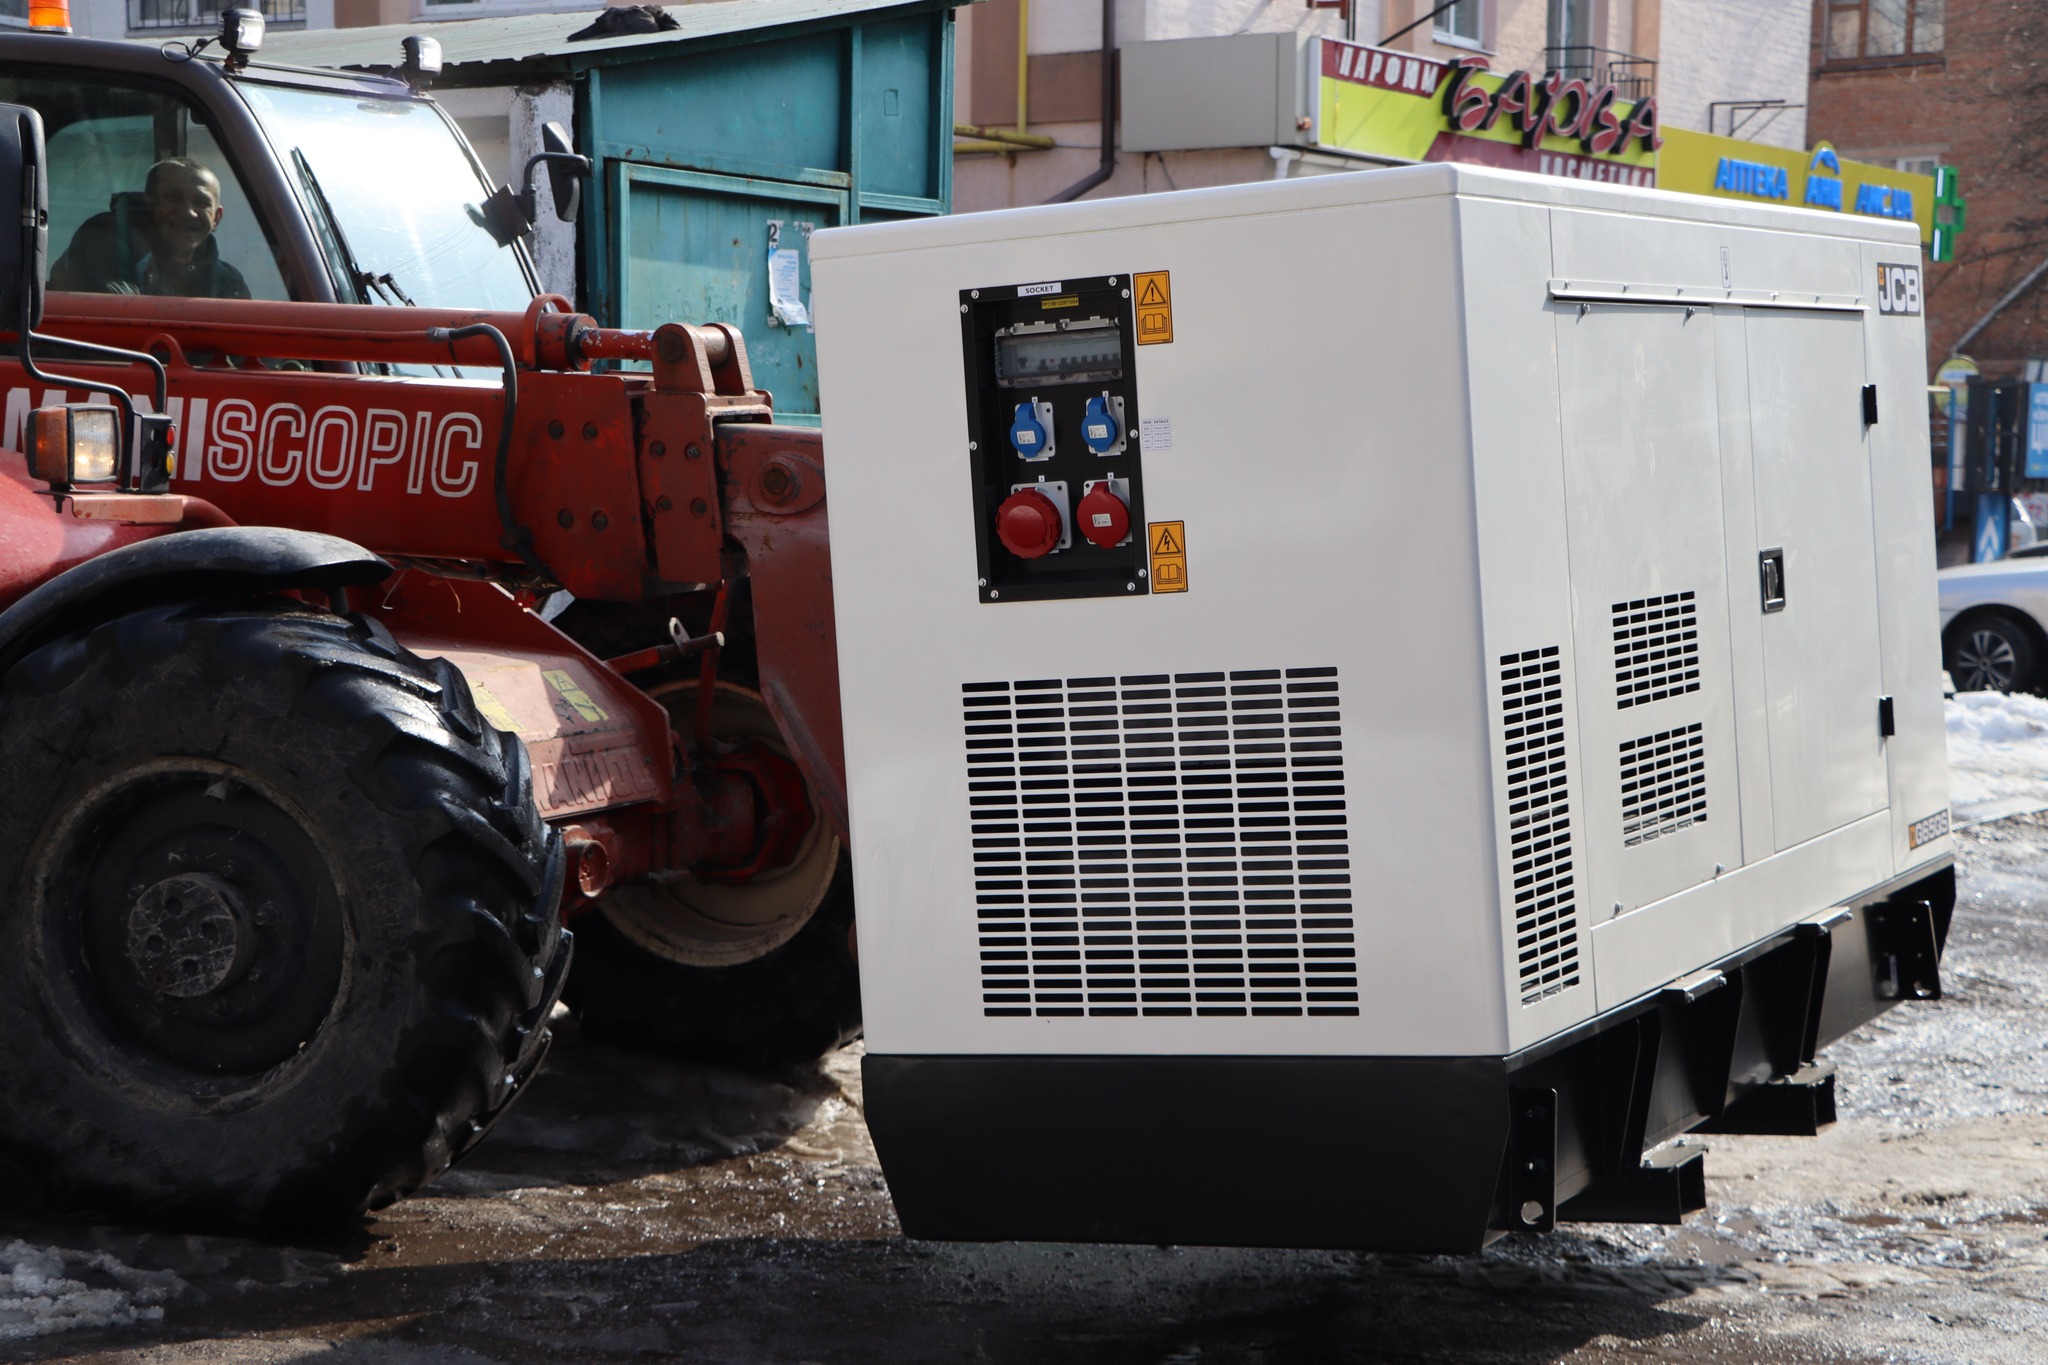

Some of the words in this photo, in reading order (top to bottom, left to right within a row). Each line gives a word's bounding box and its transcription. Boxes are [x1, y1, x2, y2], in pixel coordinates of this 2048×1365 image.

[1448, 57, 1664, 154] БАРВА
[1714, 156, 1789, 200] АПТЕКА
[1025, 285, 1054, 294] SOCKET
[1878, 266, 1920, 312] JCB
